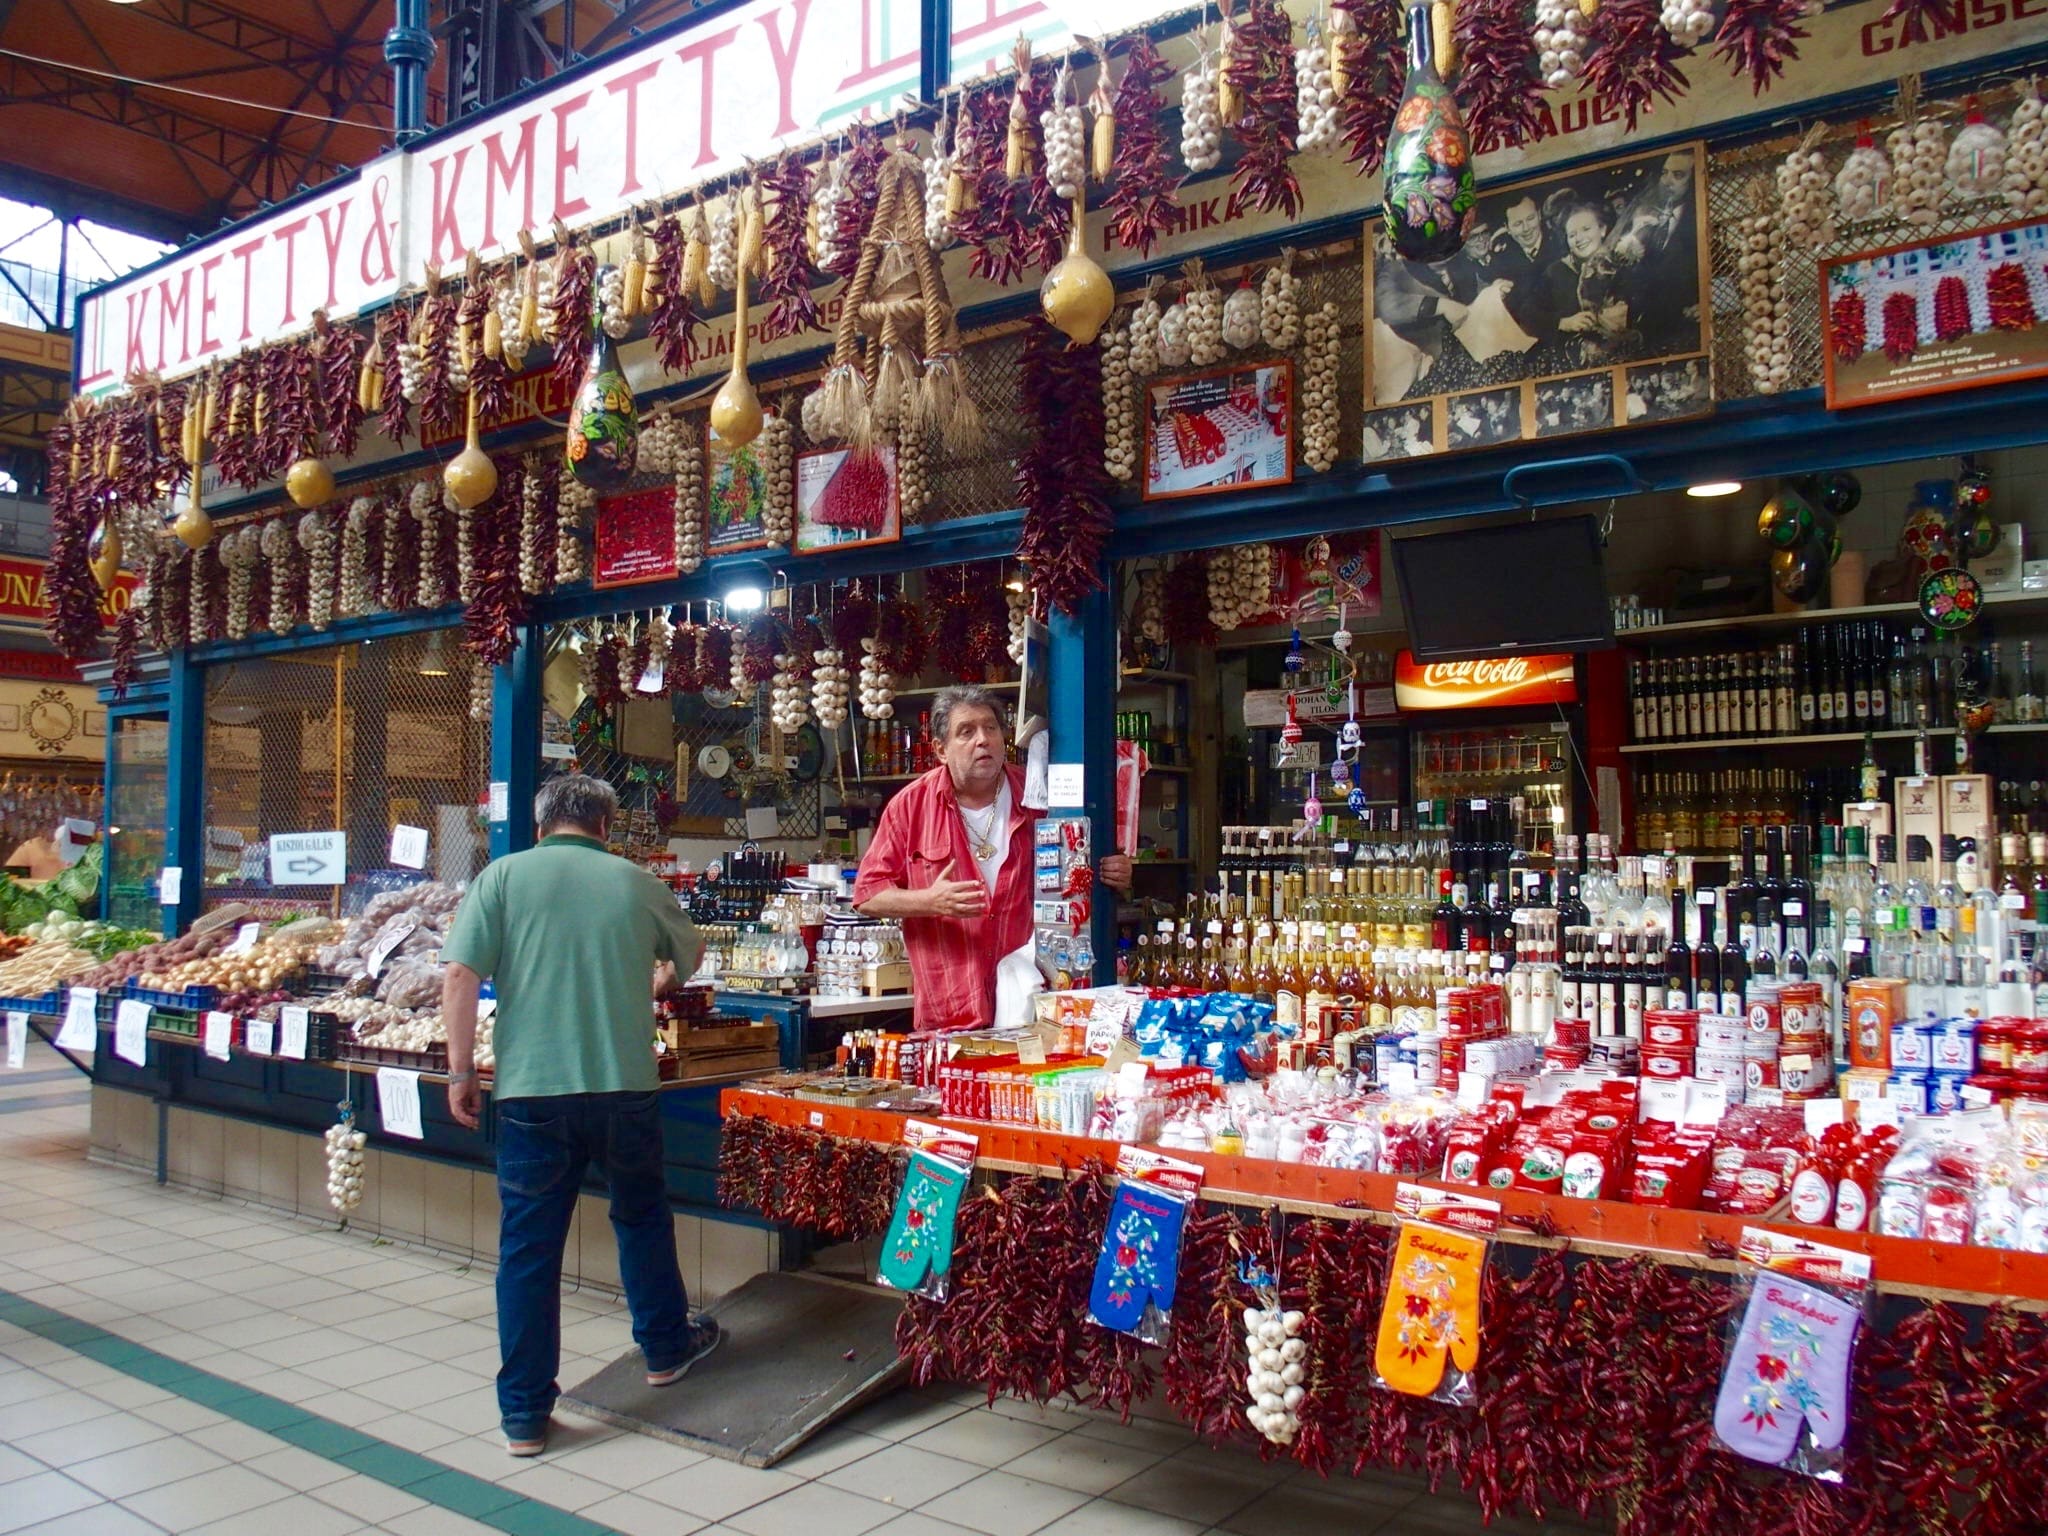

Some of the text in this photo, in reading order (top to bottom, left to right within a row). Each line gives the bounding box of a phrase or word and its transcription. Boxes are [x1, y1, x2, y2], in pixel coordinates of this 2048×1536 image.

[125, 0, 811, 379] KMETTY & KMETTY
[1409, 1235, 1468, 1260] Budapest
[1765, 1287, 1839, 1325] Budapest
